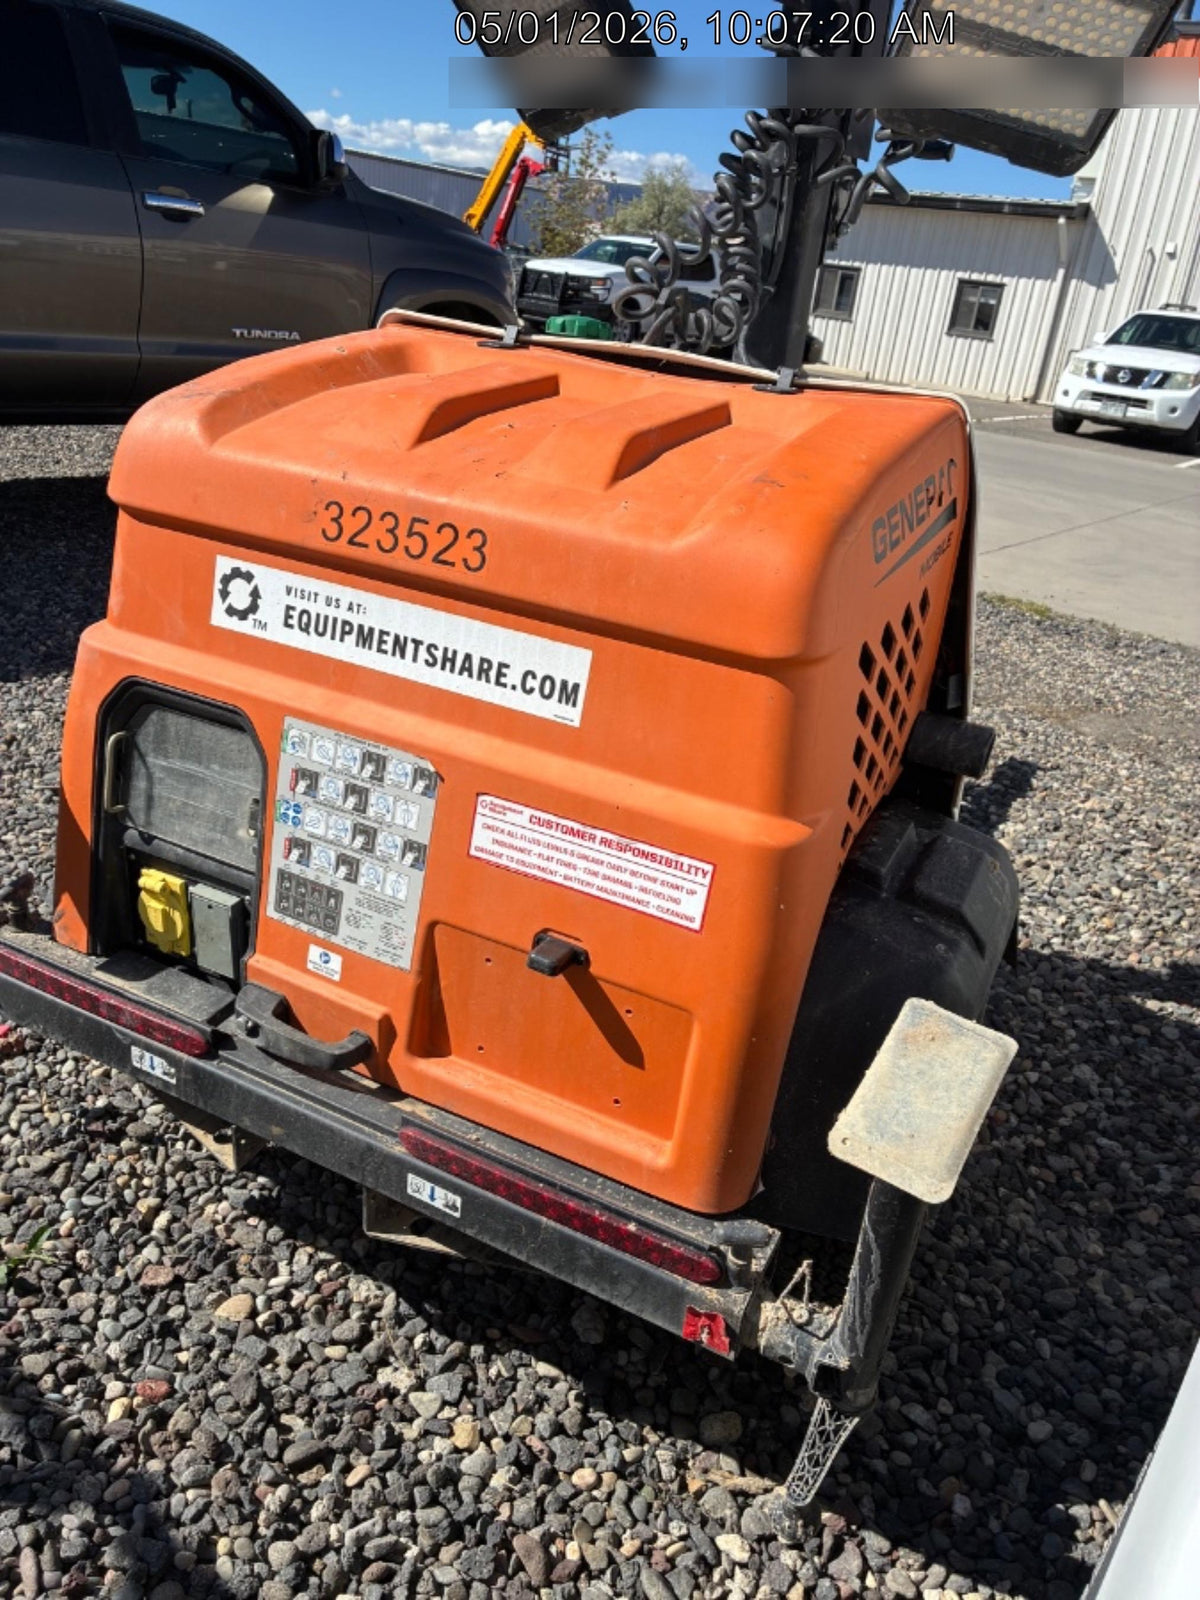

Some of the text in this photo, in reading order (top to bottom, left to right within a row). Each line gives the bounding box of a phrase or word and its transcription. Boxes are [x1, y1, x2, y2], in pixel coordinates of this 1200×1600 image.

[231, 328, 301, 341] TUNDRA
[321, 500, 488, 572] 323523
[252, 618, 268, 632] TM
[285, 584, 368, 615] VISIT US AT:
[282, 604, 581, 708] EQUIPMENTSHARE.COM
[506, 830, 519, 840] ALL
[659, 879, 685, 893] START
[686, 888, 698, 897] UP
[529, 814, 709, 879] CUSTOMER RESPONSIBILITY
[538, 853, 555, 863] FLAT
[515, 858, 558, 877] EQUIPMENT
[563, 874, 595, 890] BATTERY
[596, 884, 651, 908] MAINTENANCE
[655, 904, 697, 923] CLEANING
